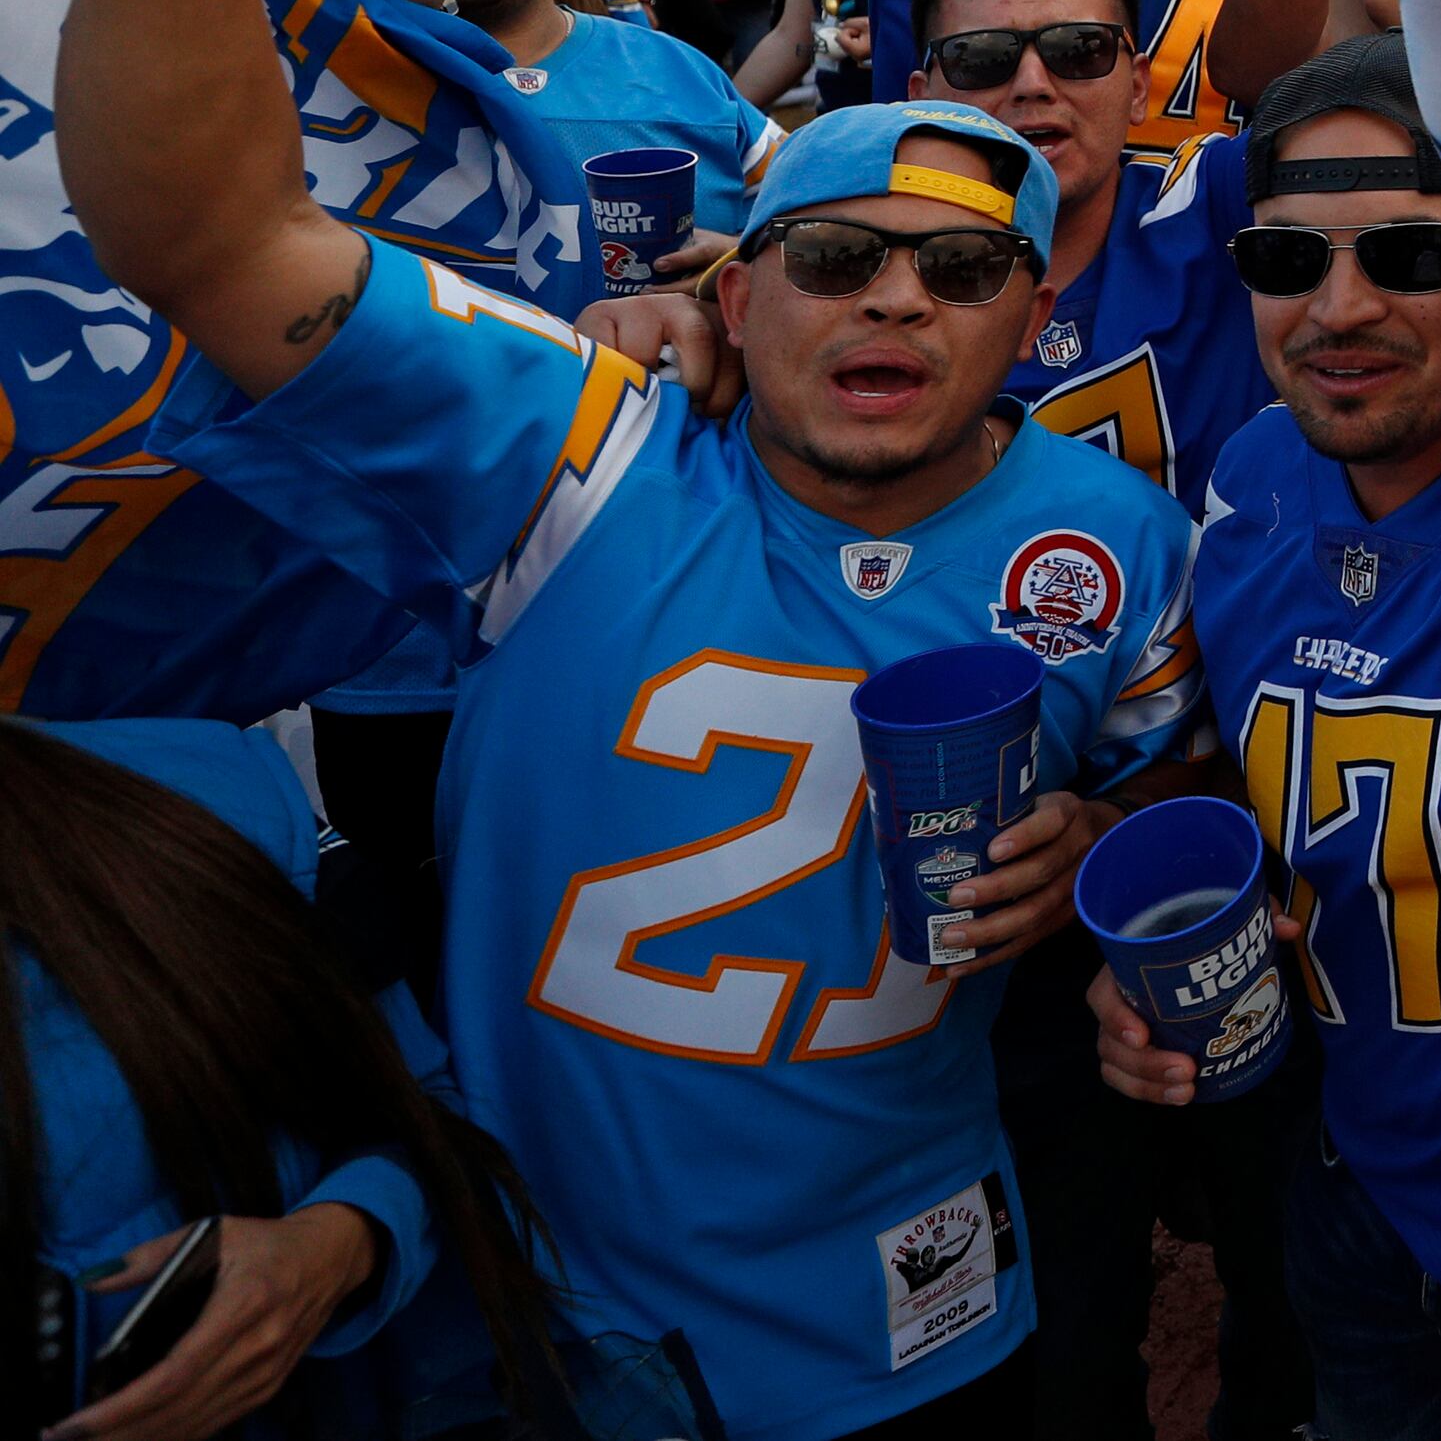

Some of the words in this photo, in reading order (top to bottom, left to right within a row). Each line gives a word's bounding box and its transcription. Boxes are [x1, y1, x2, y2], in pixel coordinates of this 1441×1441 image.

[1045, 342, 1077, 361] NFL
[849, 547, 905, 560] EQUIPMENT
[859, 570, 887, 589] NFL
[923, 870, 972, 885] MEXICO
[1174, 909, 1274, 1008] LIGHT
[1187, 906, 1266, 984] BUD
[1199, 994, 1289, 1078] CHARGE
[890, 1206, 980, 1268] THROWBACKS
[923, 1299, 969, 1335] 2009
